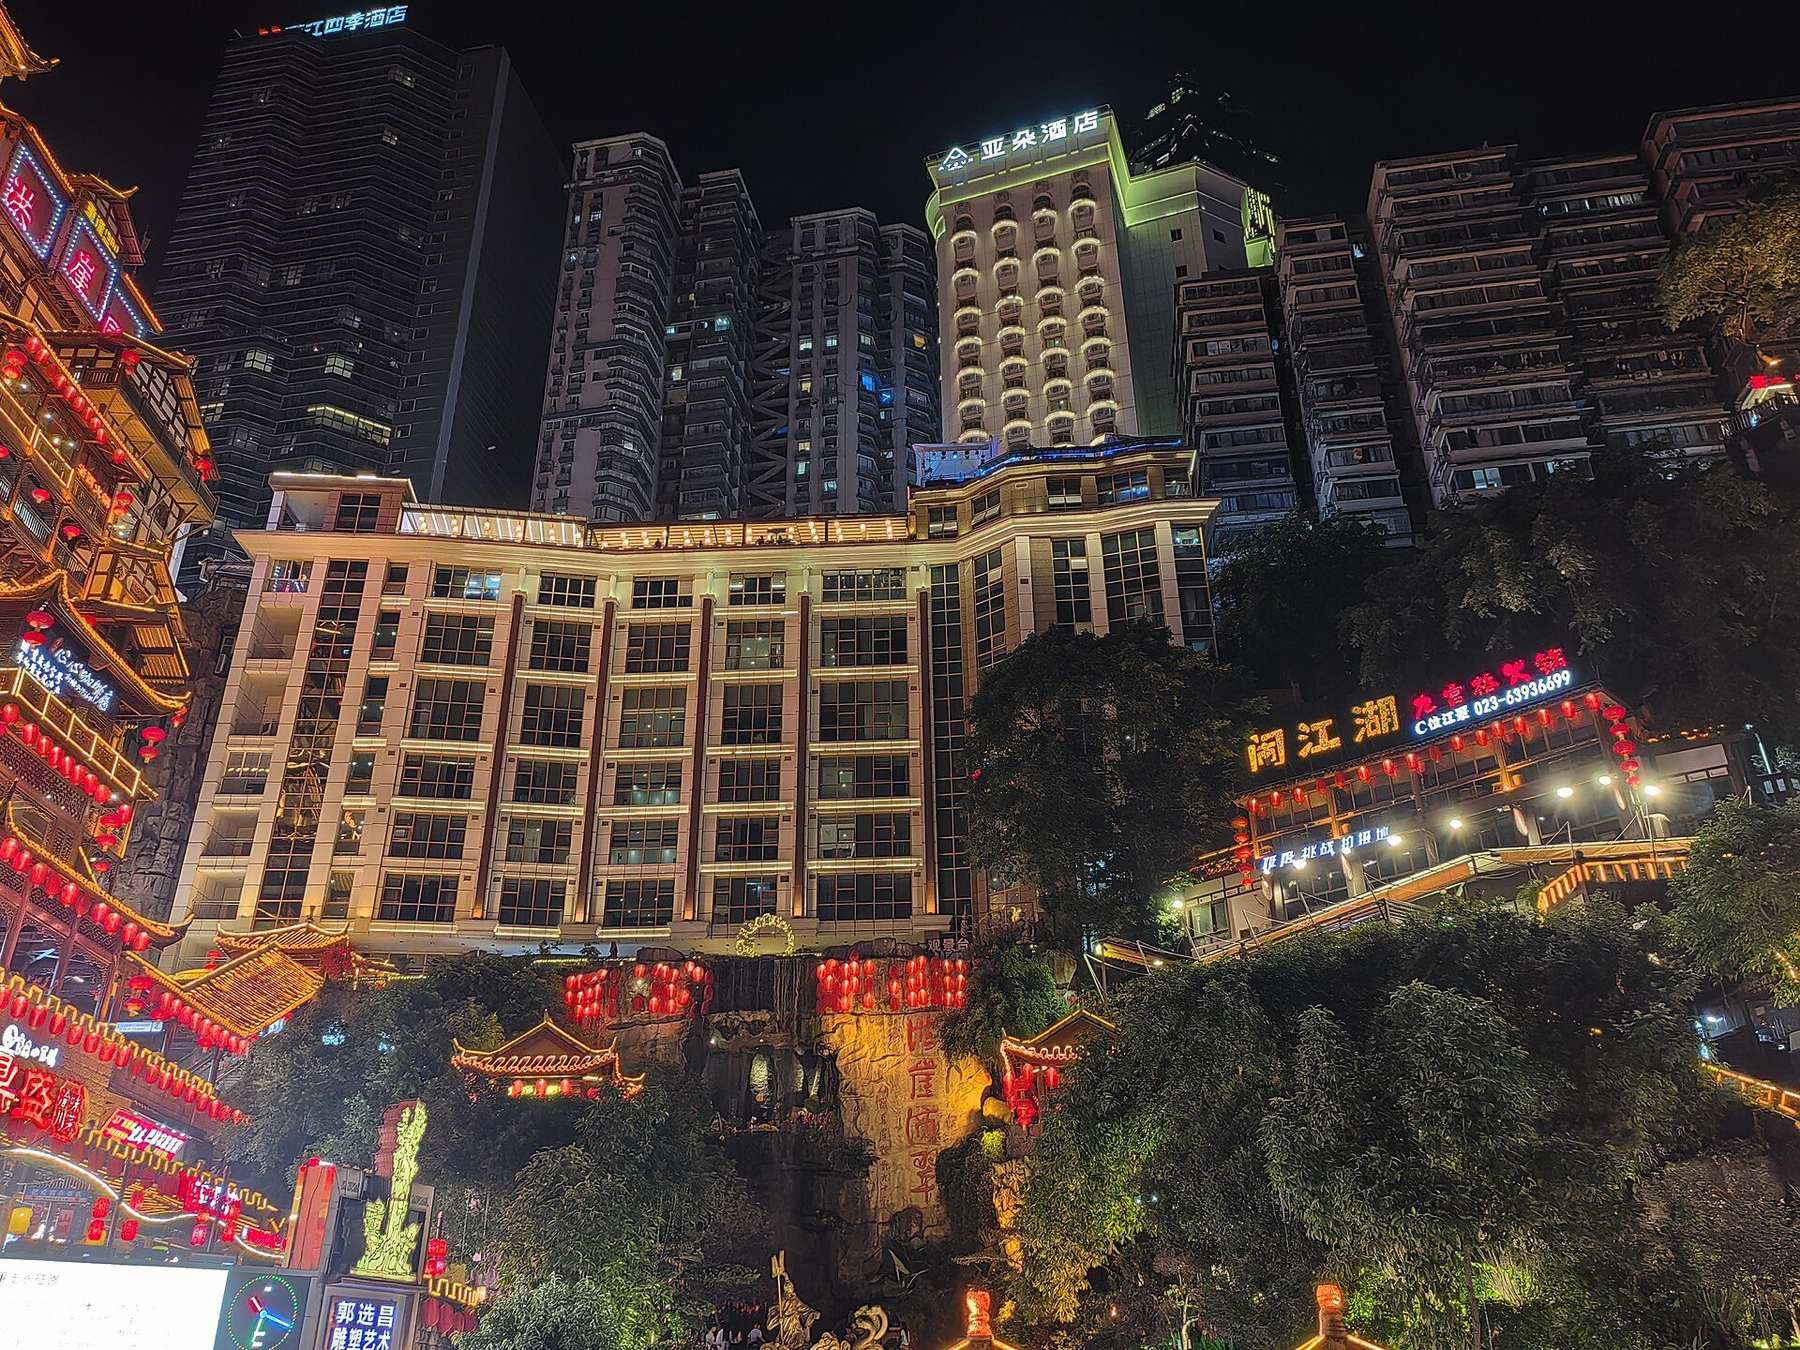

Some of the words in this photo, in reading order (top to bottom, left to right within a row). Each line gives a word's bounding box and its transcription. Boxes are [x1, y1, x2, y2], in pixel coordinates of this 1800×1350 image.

[284, 5, 409, 37] 江四季酒店
[981, 110, 1098, 161] 亚朵酒店
[1412, 648, 1567, 721] 九宫格火锅
[1473, 669, 1571, 716] 023-63936699
[1248, 695, 1399, 773] 闹江湖
[336, 1301, 394, 1328] 郭选昌
[331, 1327, 391, 1350] 雕塑艺术
